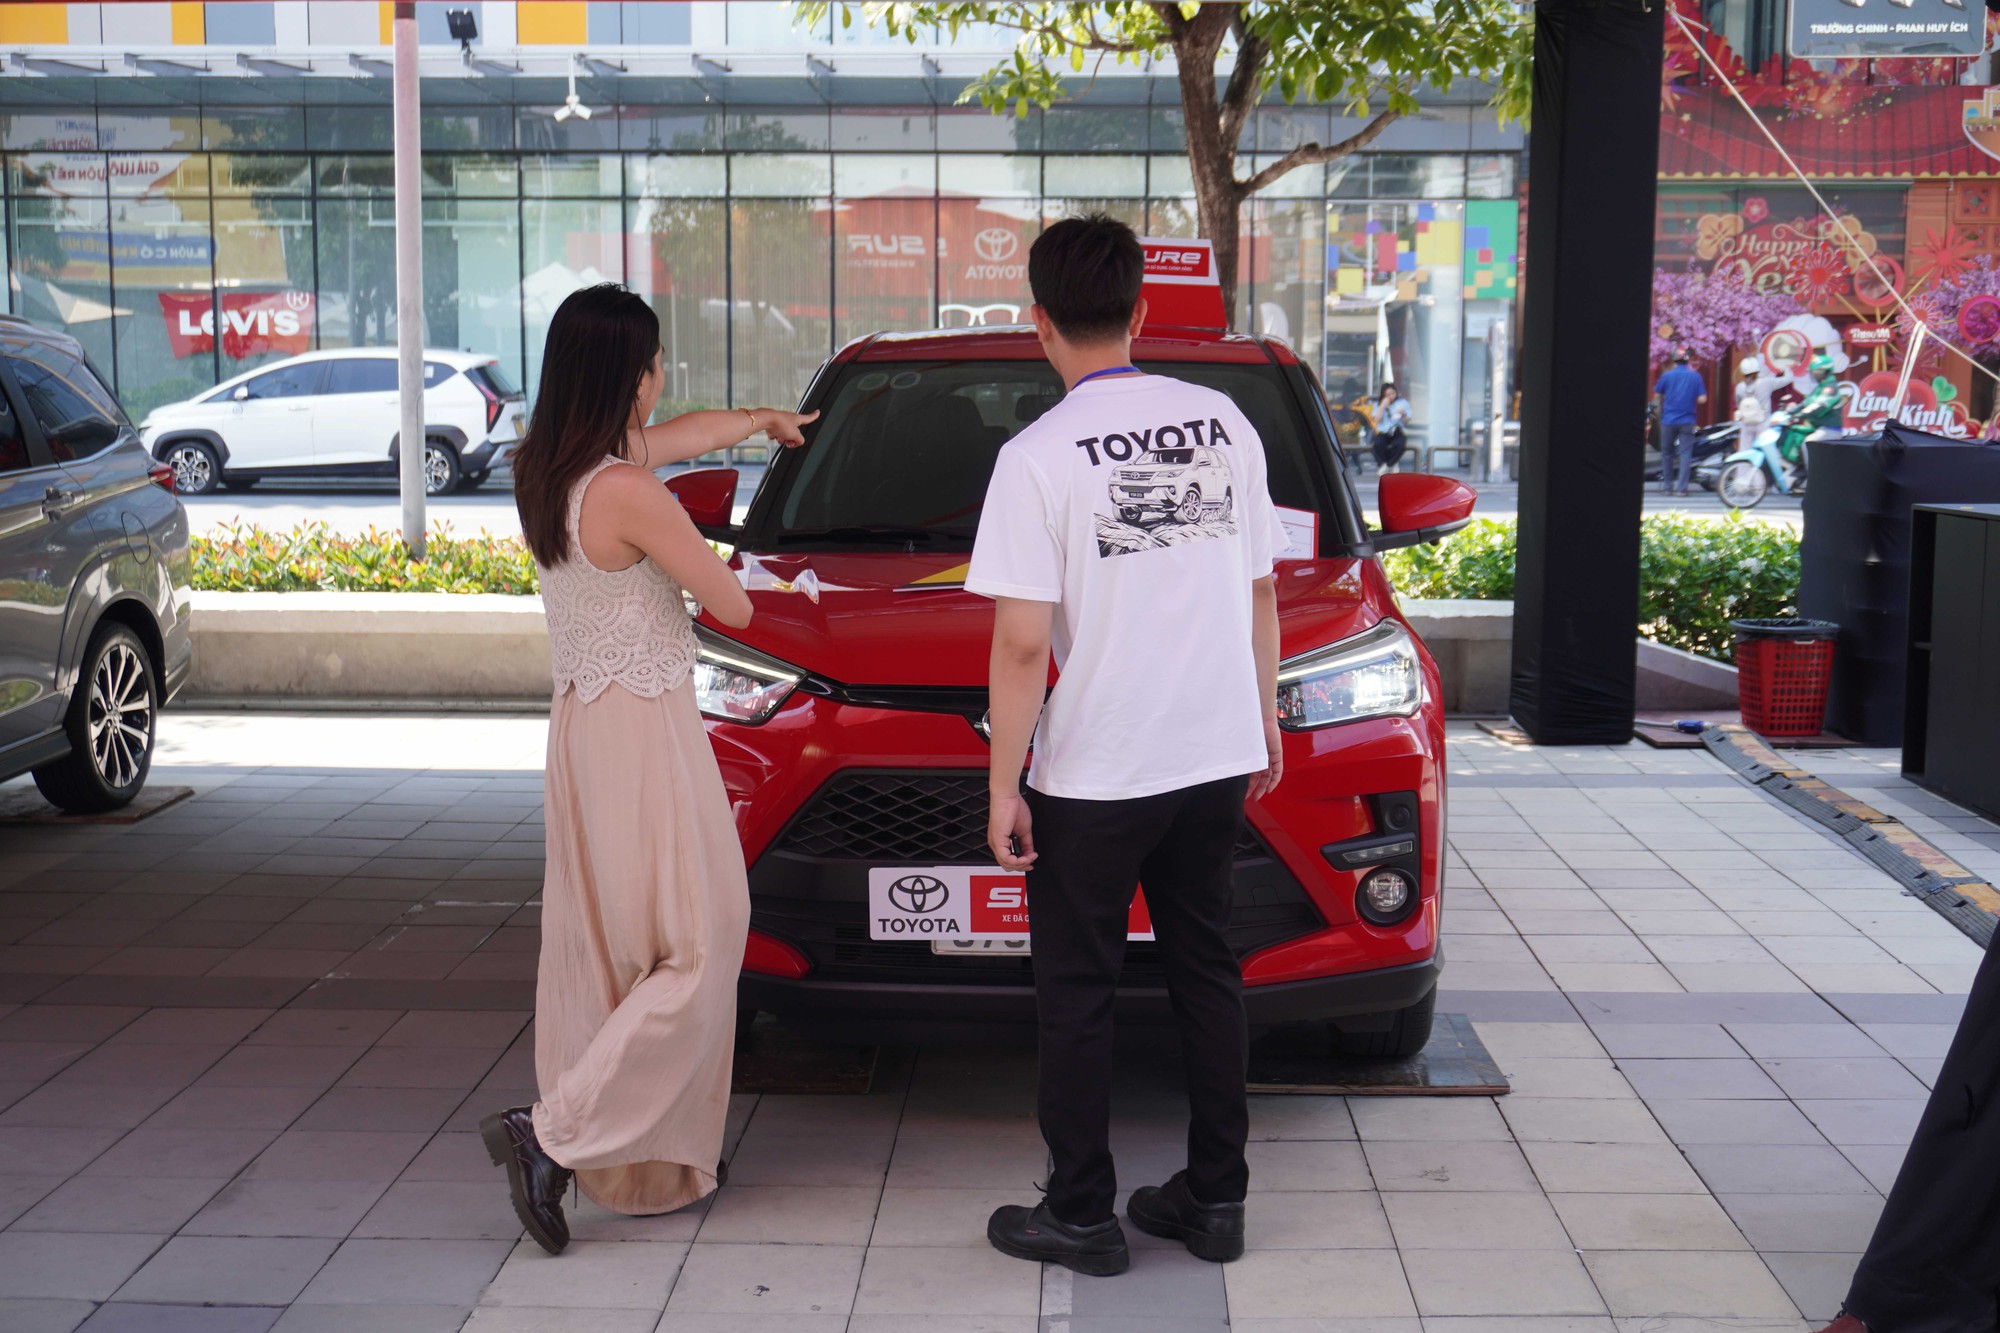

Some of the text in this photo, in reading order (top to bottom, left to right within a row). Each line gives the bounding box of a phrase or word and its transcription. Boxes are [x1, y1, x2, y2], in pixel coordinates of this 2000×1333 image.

[1810, 21, 1854, 34] TRƯỜNG
[1855, 23, 1888, 34] CHINH
[1895, 23, 1925, 33] PHAN
[1926, 23, 1948, 33] HUY
[1949, 21, 1968, 32] ÍCH
[1076, 418, 1232, 467] TOYOTA
[986, 887, 1029, 909] S
[1002, 914, 1011, 923] XE
[1013, 912, 1023, 923] ĐÃ
[878, 918, 961, 934] TOYOTA
